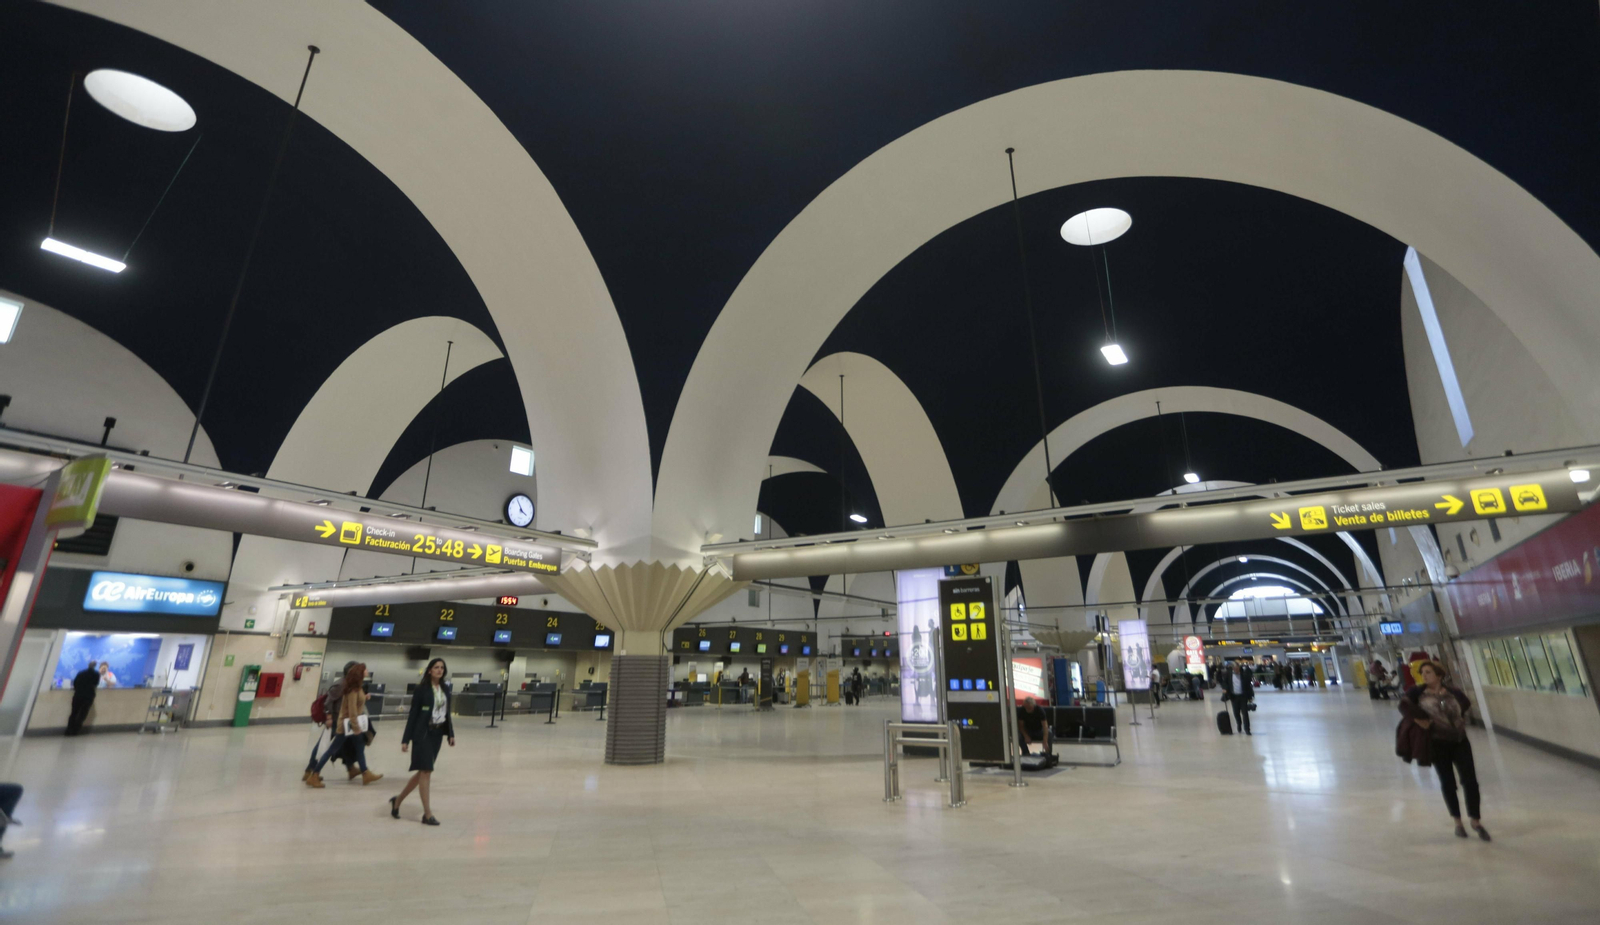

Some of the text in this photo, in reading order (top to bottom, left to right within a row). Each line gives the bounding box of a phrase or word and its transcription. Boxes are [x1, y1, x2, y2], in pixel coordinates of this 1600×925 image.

[1331, 501, 1386, 514] Ticket sales
[1333, 509, 1430, 527] Venta de billetes
[366, 525, 396, 538] Check-in
[365, 535, 411, 551] Facturación
[412, 533, 465, 558] 25 to a 48
[504, 547, 543, 560] Boarding Gates
[503, 557, 558, 572] Puertas Embarque
[1551, 559, 1581, 582] IBERIA
[375, 603, 390, 616] 21
[440, 608, 454, 621] 22
[495, 613, 508, 625] 23
[546, 617, 558, 628] 24
[698, 628, 707, 637] 26
[729, 630, 736, 639] 27
[755, 632, 763, 640] 28
